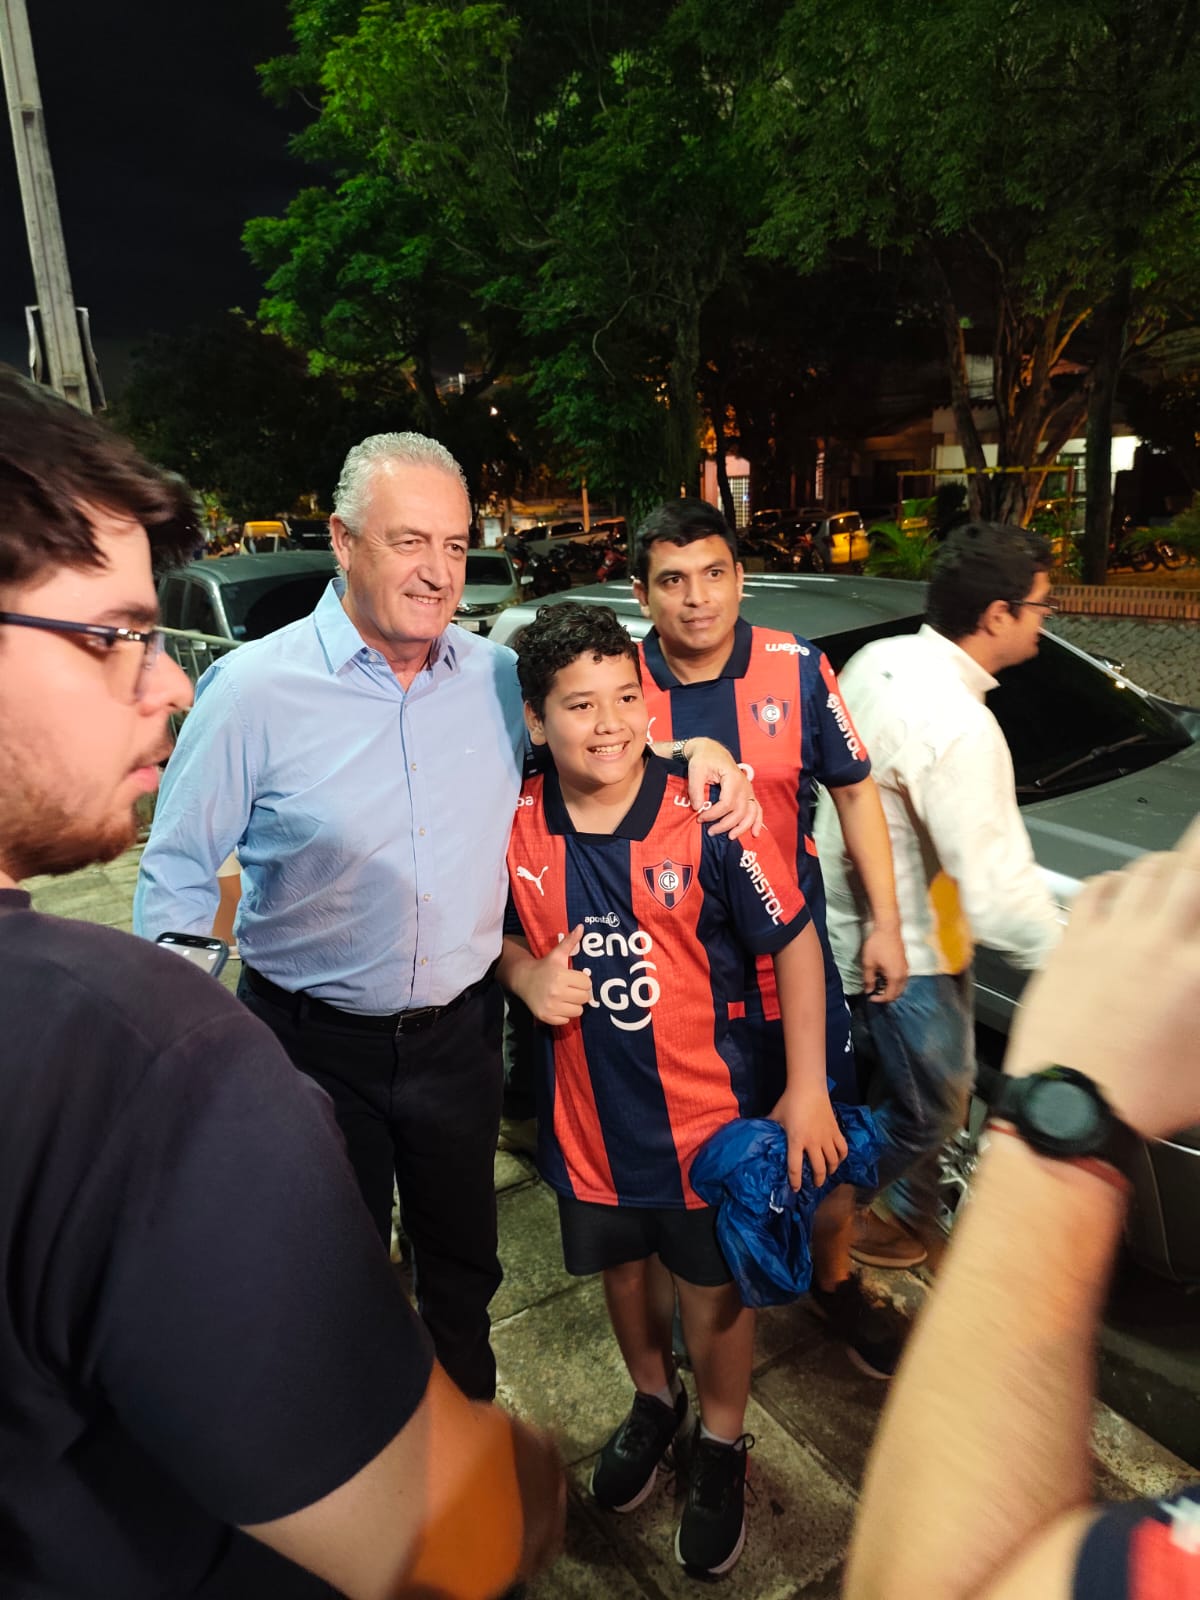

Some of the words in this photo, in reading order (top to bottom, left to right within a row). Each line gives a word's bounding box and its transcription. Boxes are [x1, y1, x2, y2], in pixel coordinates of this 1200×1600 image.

[765, 643, 811, 656] wepa
[827, 692, 860, 760] BRISTOL
[517, 795, 534, 811] pa
[674, 795, 712, 813] wp
[739, 849, 785, 926] BRISTOL
